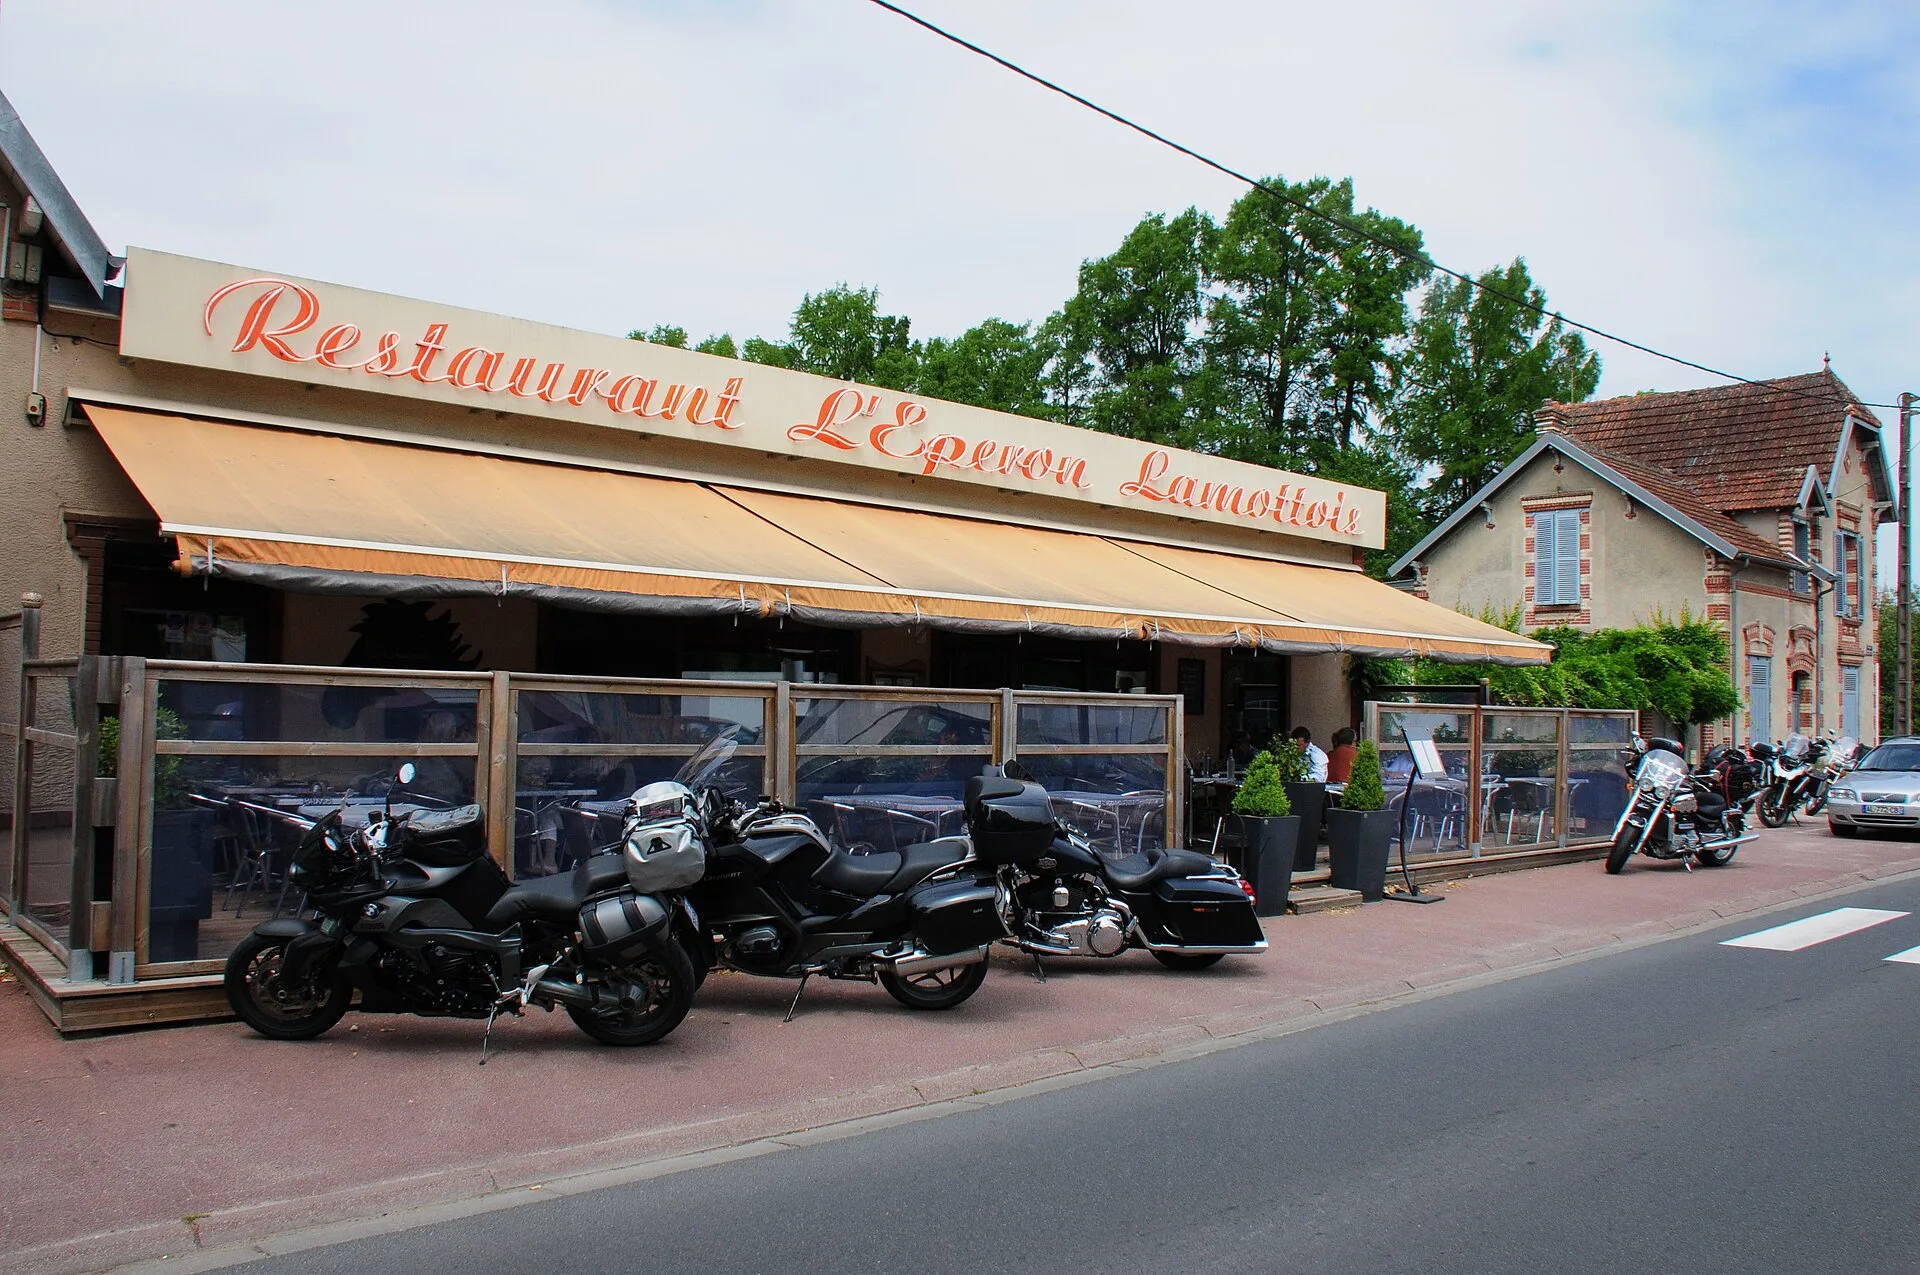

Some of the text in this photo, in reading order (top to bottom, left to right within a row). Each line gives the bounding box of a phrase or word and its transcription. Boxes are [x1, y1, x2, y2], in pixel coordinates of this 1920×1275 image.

[203, 277, 1365, 536] Restaurant L'Eperon Lamottois
